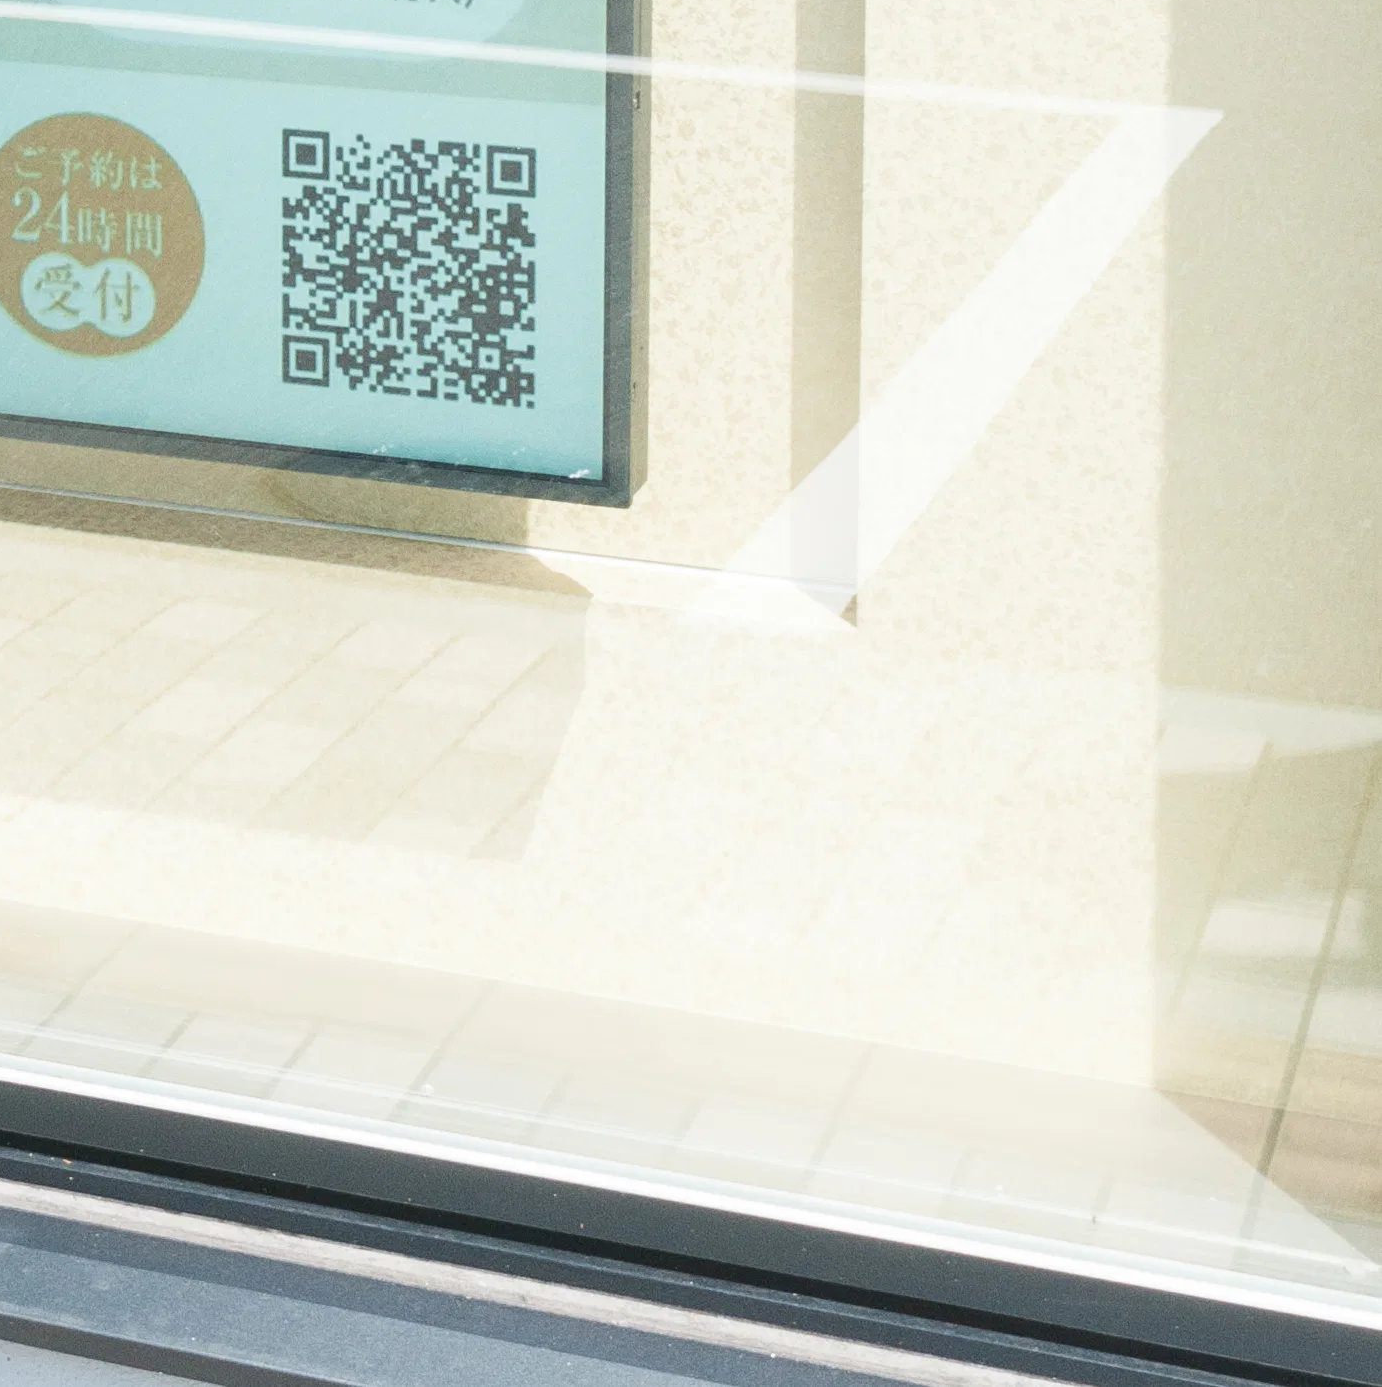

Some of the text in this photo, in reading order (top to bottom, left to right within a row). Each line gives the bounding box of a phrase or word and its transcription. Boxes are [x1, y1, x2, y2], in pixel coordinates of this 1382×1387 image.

[13, 145, 164, 191] ご予約は
[11, 186, 164, 259] 24時間
[33, 264, 142, 324] 受付
